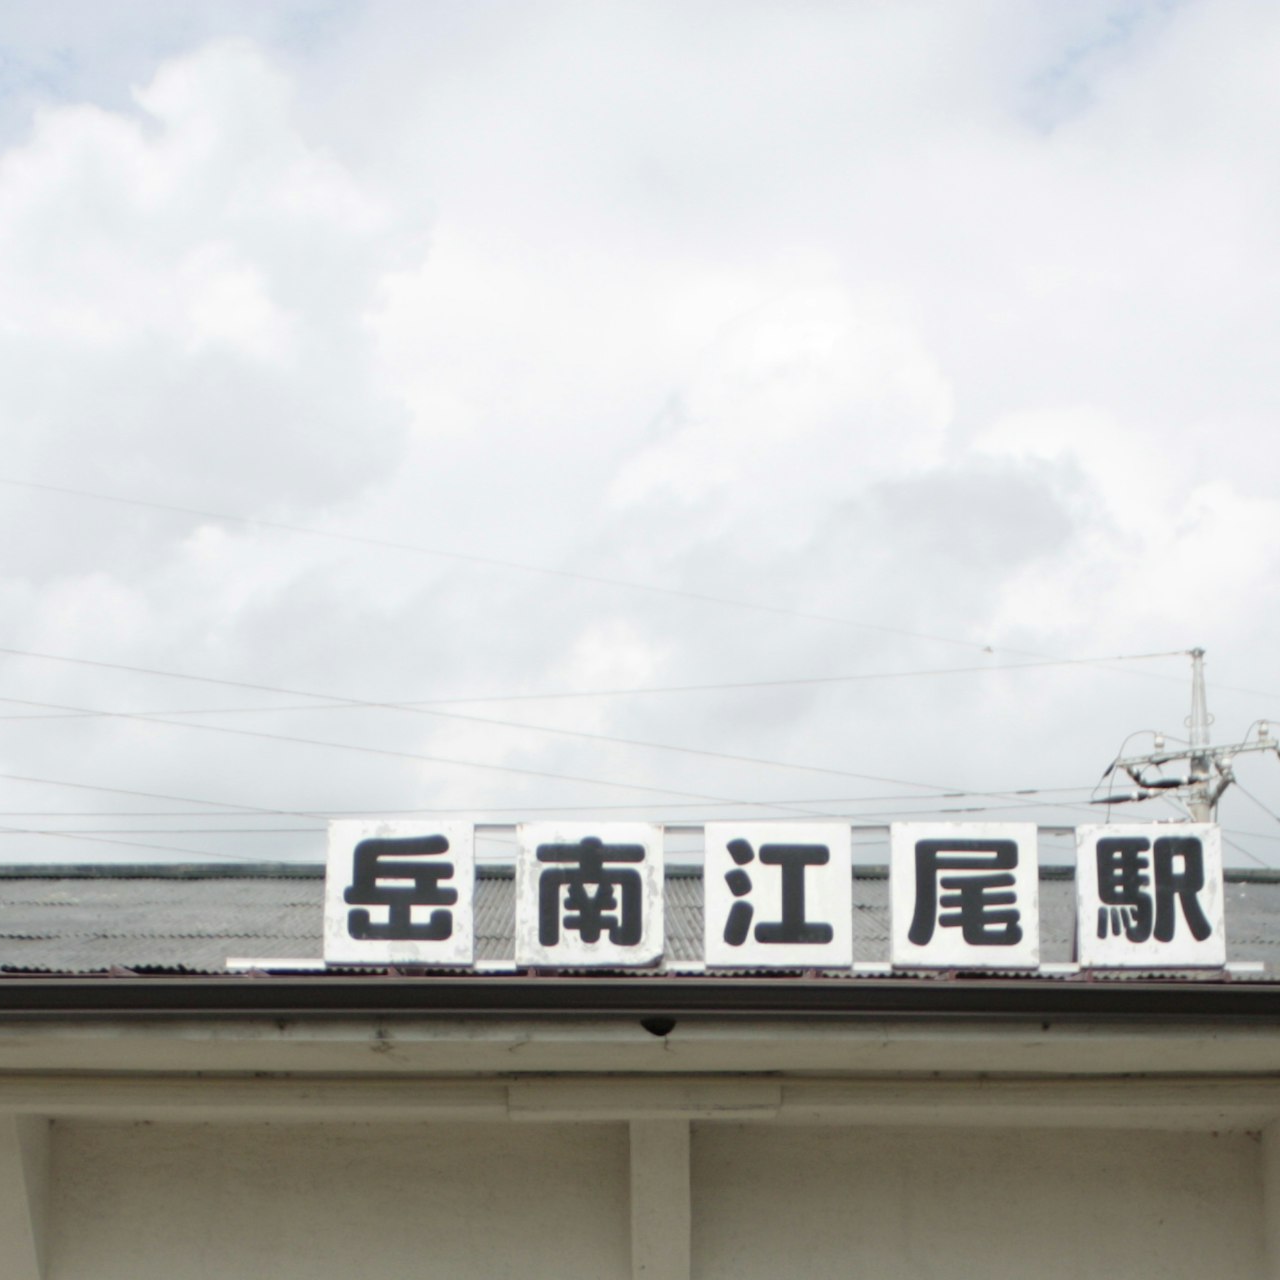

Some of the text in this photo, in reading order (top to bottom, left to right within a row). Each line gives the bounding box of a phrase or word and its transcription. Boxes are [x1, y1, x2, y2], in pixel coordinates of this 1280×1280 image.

[342, 834, 1214, 948] 岳南江尾駅
